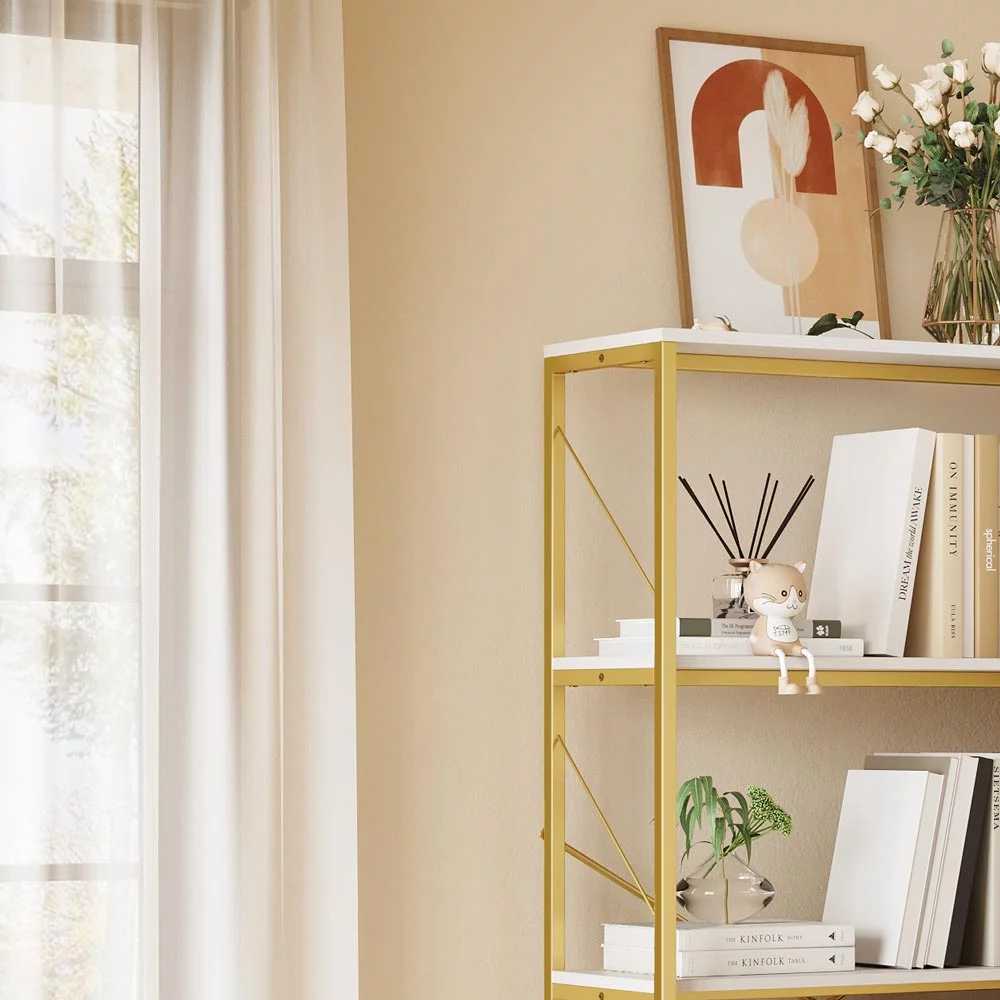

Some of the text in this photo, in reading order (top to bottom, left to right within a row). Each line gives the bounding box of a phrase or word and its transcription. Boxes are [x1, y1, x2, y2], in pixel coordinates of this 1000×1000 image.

[949, 462, 957, 557] ON IMMUNITY
[898, 486, 923, 601] DREAM the world AWAKE
[983, 528, 997, 572] spherical
[740, 934, 784, 944] KINFOLK
[742, 957, 785, 967] KINFOLK
